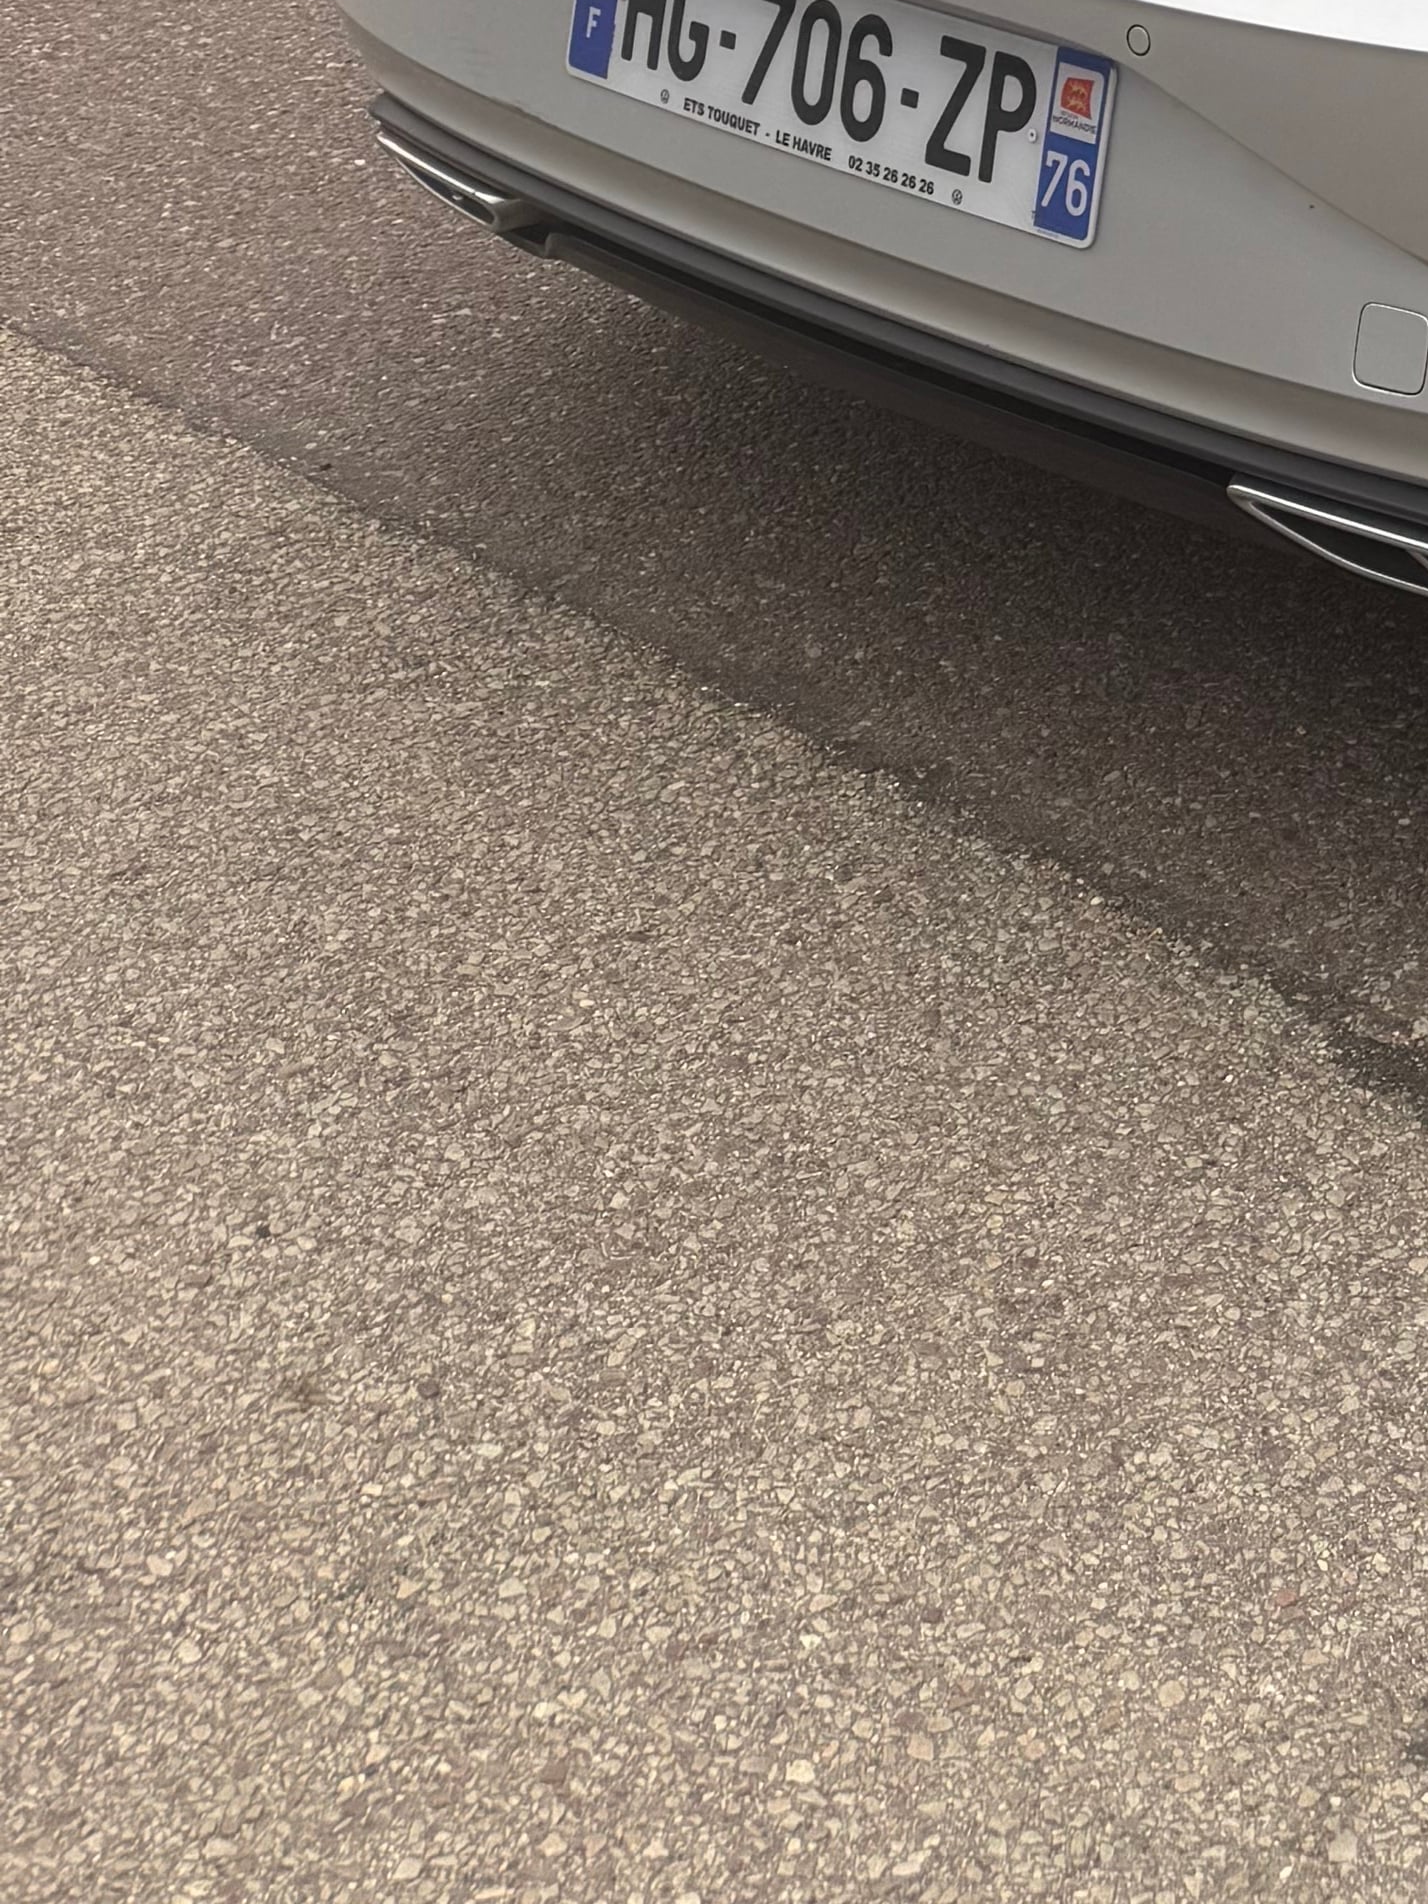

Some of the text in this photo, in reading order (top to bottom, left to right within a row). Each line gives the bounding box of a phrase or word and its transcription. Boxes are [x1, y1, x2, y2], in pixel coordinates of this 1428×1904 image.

[585, 7, 602, 40] F
[683, 97, 704, 116] ETS
[707, 105, 761, 136] TOUQUET
[775, 130, 790, 147] LE
[792, 134, 832, 161] HAVRE
[848, 155, 862, 172] 02
[865, 160, 880, 178] 35
[883, 166, 898, 184] 26
[901, 172, 916, 189] 26
[919, 177, 934, 195] 26
[1041, 150, 1090, 216] 76
